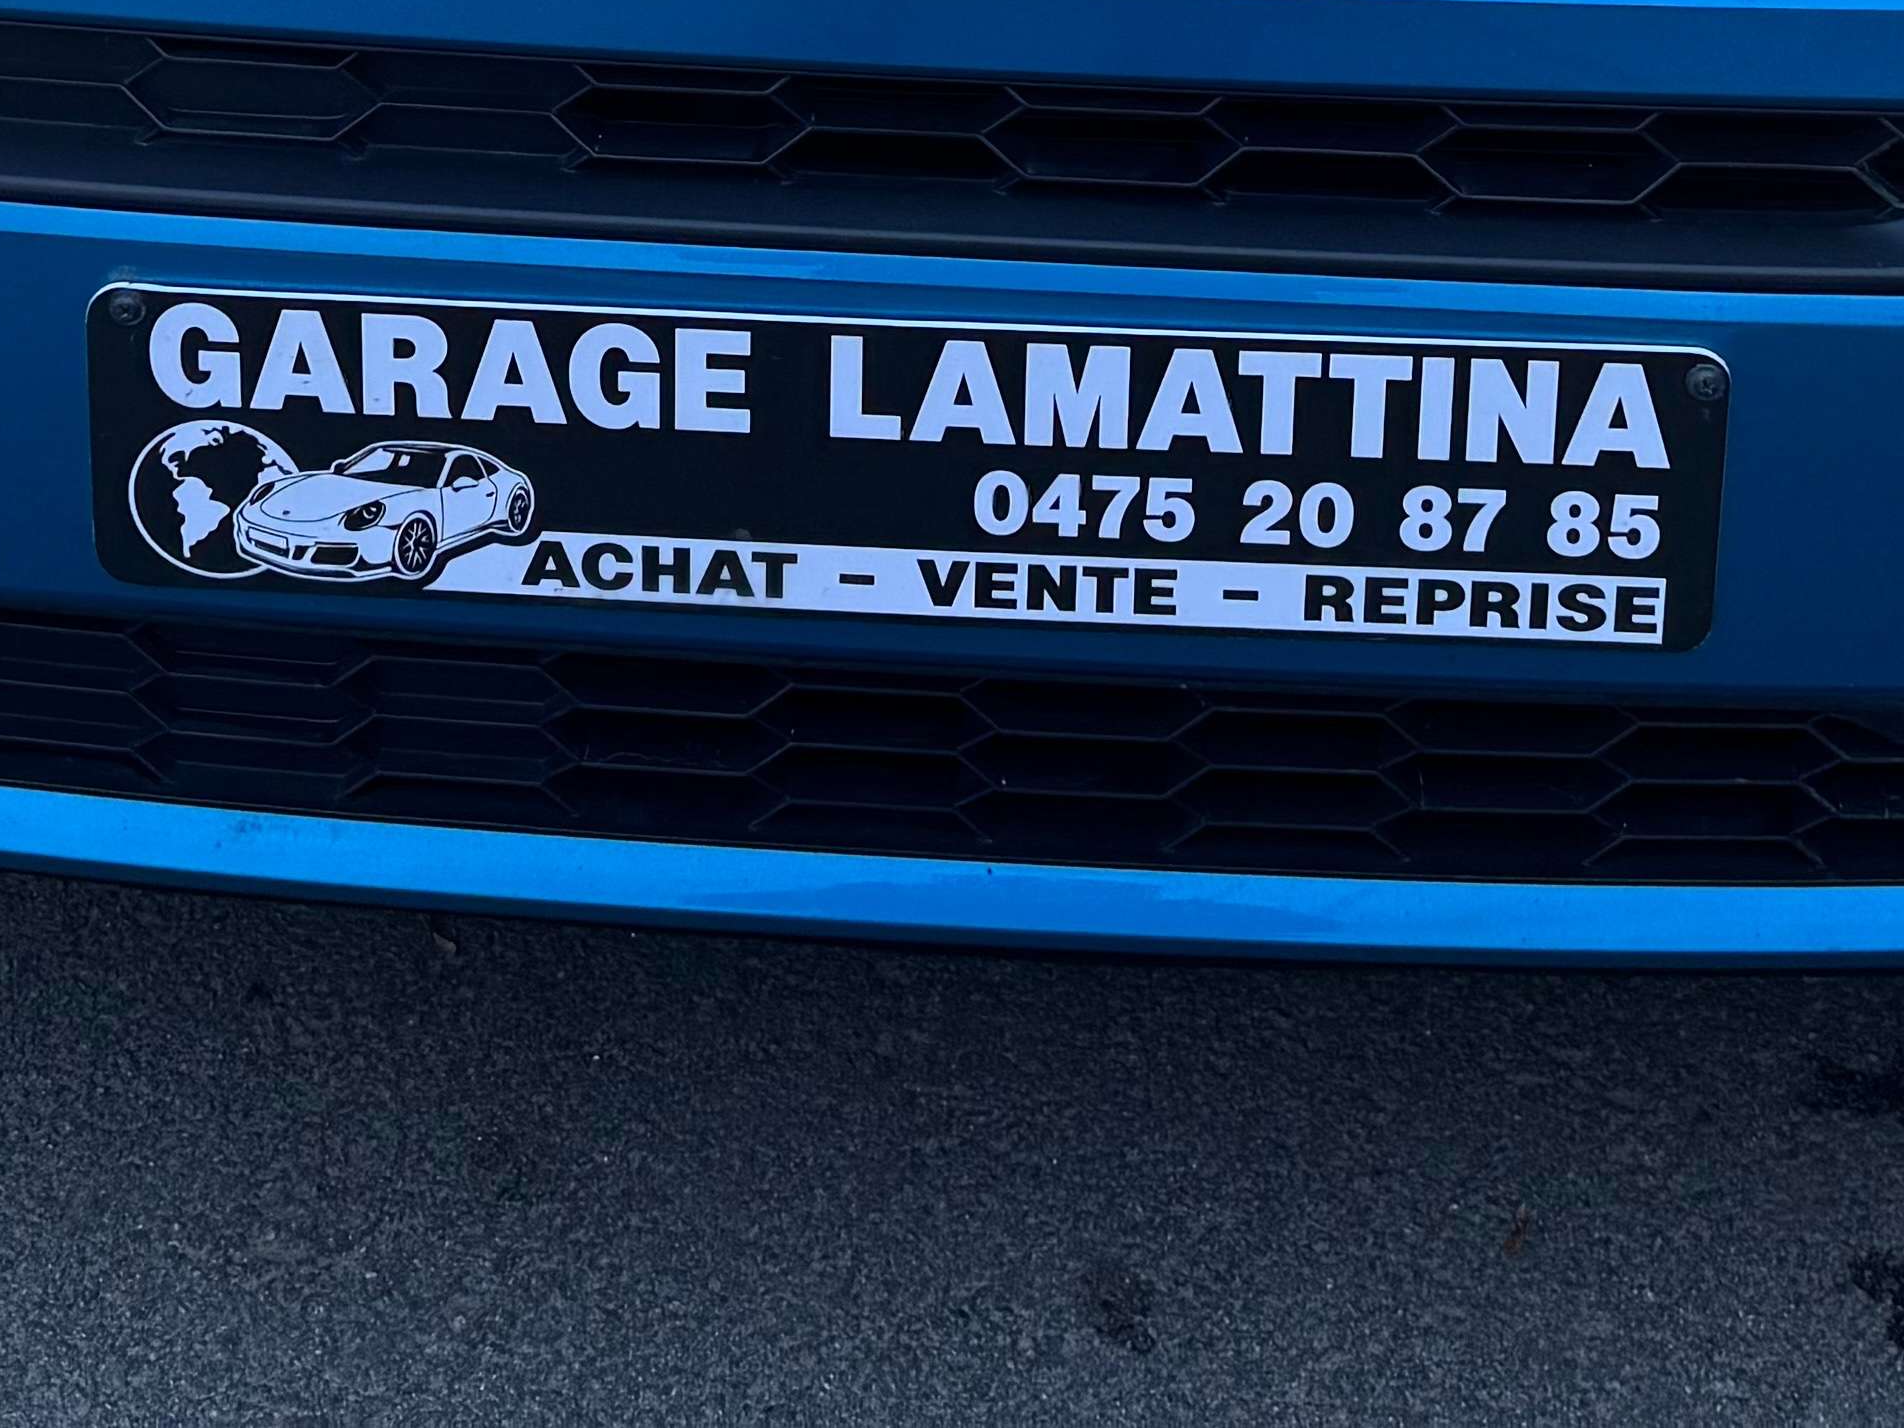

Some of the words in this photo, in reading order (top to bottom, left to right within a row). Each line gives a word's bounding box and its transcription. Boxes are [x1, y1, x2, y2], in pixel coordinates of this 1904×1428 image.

[150, 303, 751, 433] GARAGE
[830, 335, 1670, 469] LAMATTINA
[974, 471, 1195, 542] 0475
[1240, 480, 1354, 548] 20
[1400, 486, 1506, 552] 87
[1547, 491, 1660, 559] 85
[522, 541, 797, 598] ACHAT
[917, 559, 1177, 615] VENTE
[1304, 575, 1659, 633] REPRISE
